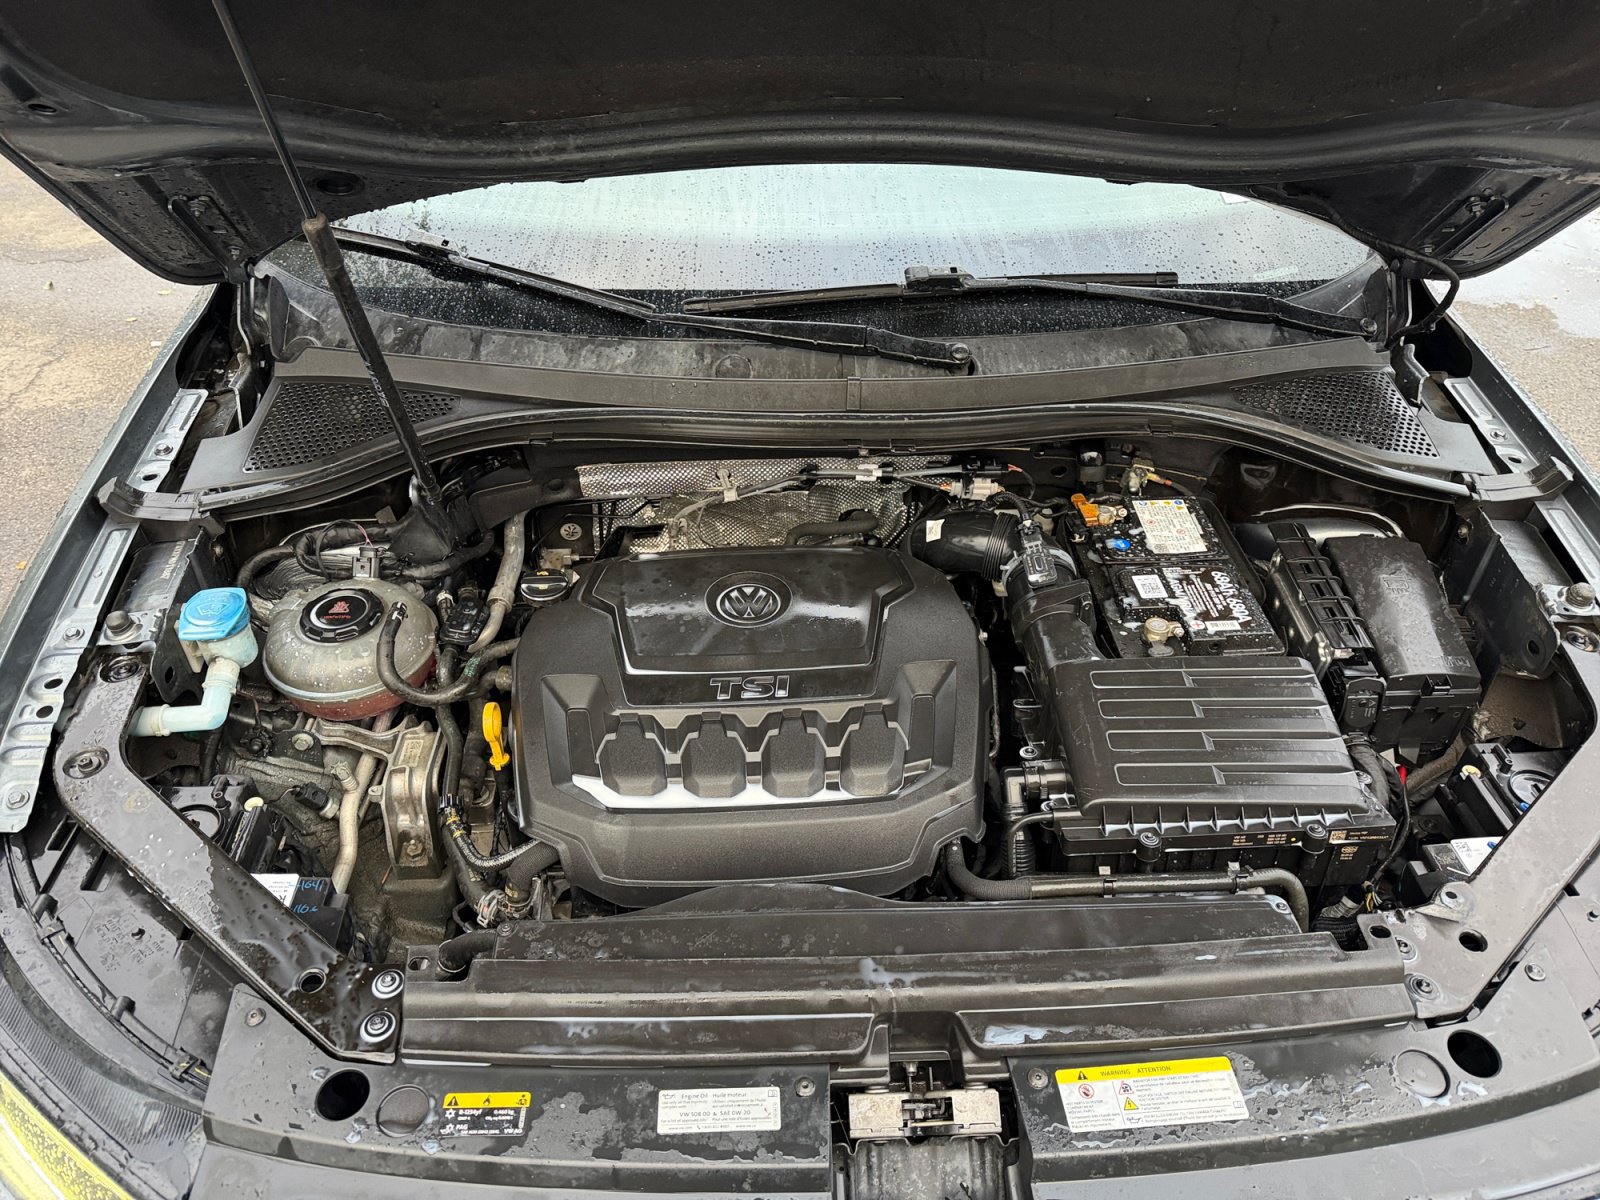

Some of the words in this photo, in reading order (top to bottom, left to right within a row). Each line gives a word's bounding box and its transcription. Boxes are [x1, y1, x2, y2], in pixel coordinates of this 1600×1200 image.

[1211, 571, 1238, 597] 68Ah
[1226, 597, 1253, 623] 680A
[709, 675, 790, 700] TSI
[1100, 1069, 1131, 1077] WARNING
[1137, 1065, 1171, 1074] ATTENTION
[681, 1093, 700, 1101] Engine
